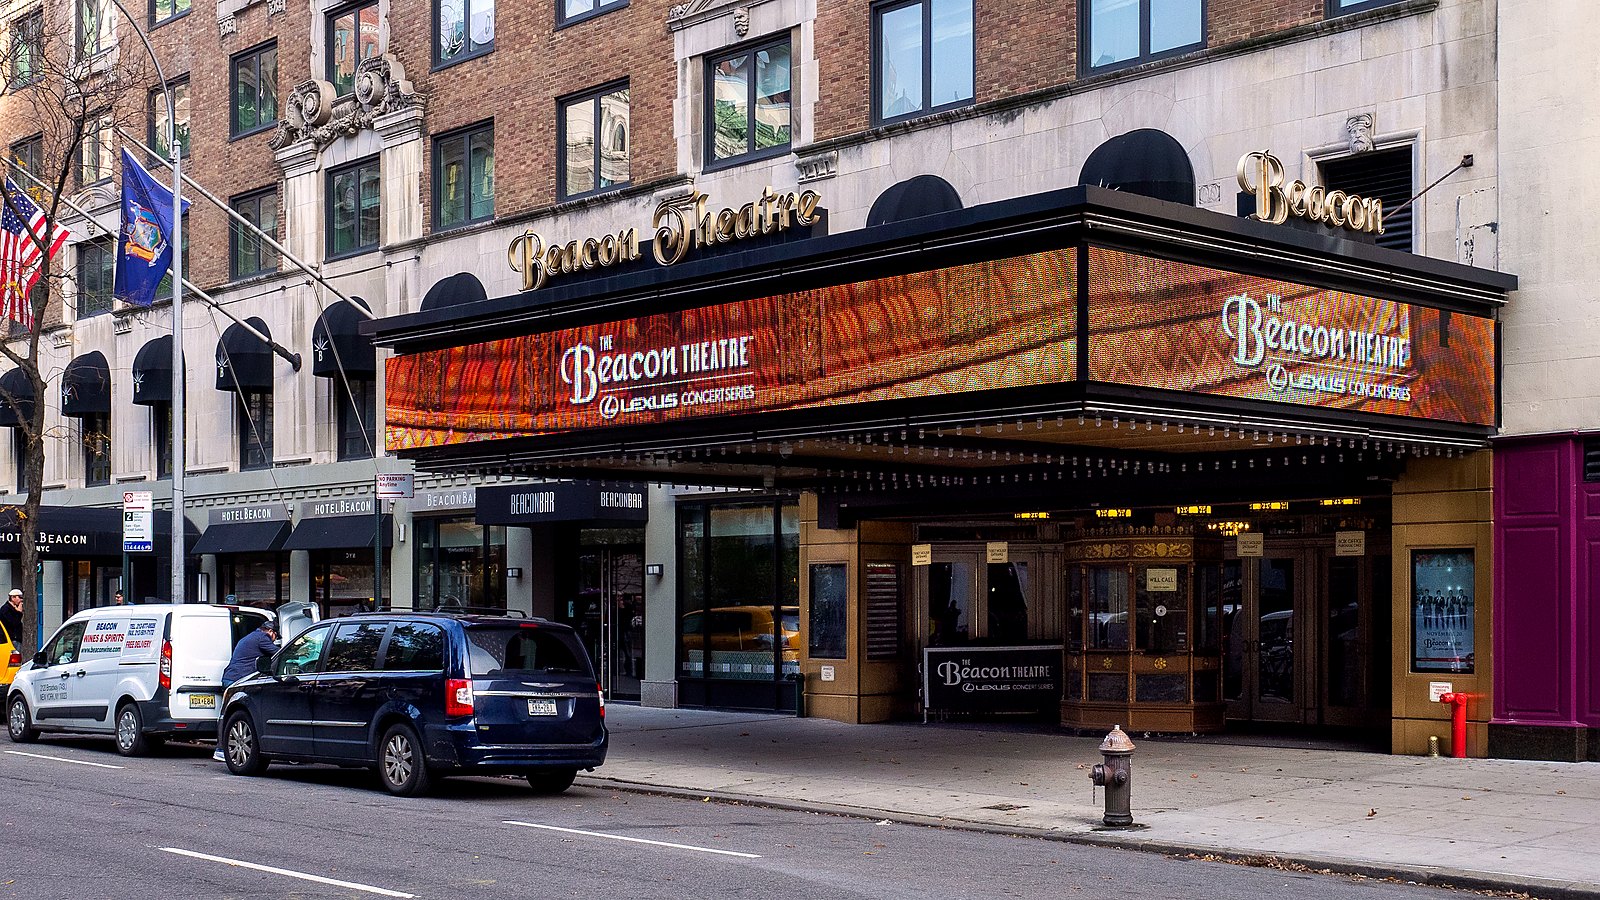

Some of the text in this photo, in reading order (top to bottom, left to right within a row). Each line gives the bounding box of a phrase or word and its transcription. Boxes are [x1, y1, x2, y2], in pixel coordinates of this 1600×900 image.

[1237, 149, 1385, 235] Beacon
[507, 186, 821, 292] Beacon Theatre
[1266, 294, 1281, 313] THE
[1222, 292, 1408, 368] Beacon THEATRE
[599, 335, 613, 351] THE
[561, 336, 750, 404] Beacon THEATRE
[620, 393, 678, 413] LEXUS
[681, 388, 725, 407] CONCERT
[39, 532, 88, 545] BEACON
[83, 634, 100, 643] WINES
[104, 633, 125, 643] SPIRITS
[96, 622, 118, 631] BEACON
[937, 660, 1051, 686] Beacon THEATRE
